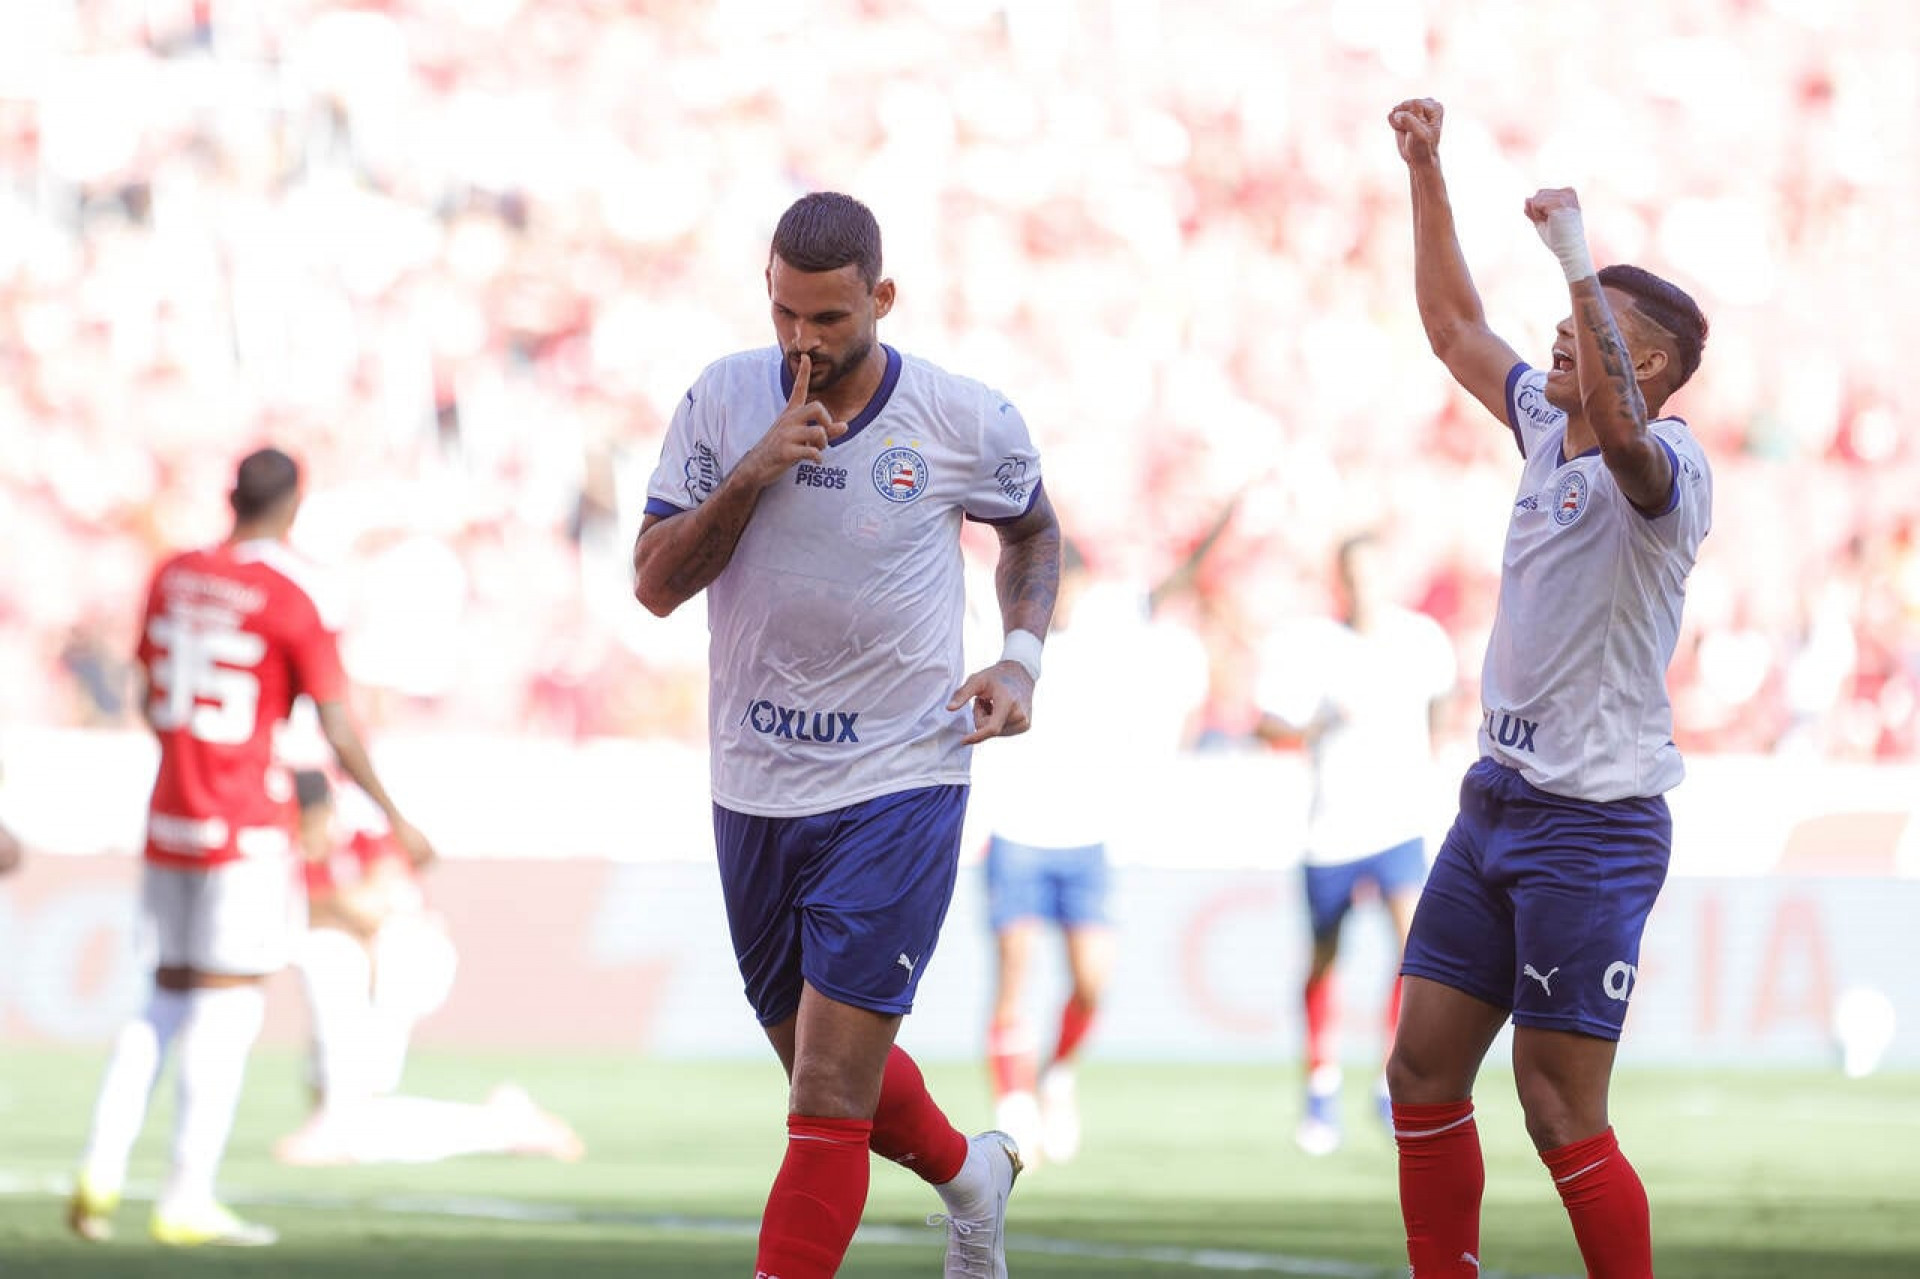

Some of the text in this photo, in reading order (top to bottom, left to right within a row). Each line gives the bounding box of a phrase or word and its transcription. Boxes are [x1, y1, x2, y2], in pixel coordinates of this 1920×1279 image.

[794, 472, 847, 490] PISOS
[797, 463, 848, 478] ATACADÃO
[150, 615, 267, 746] 35
[1483, 709, 1538, 753] LUX
